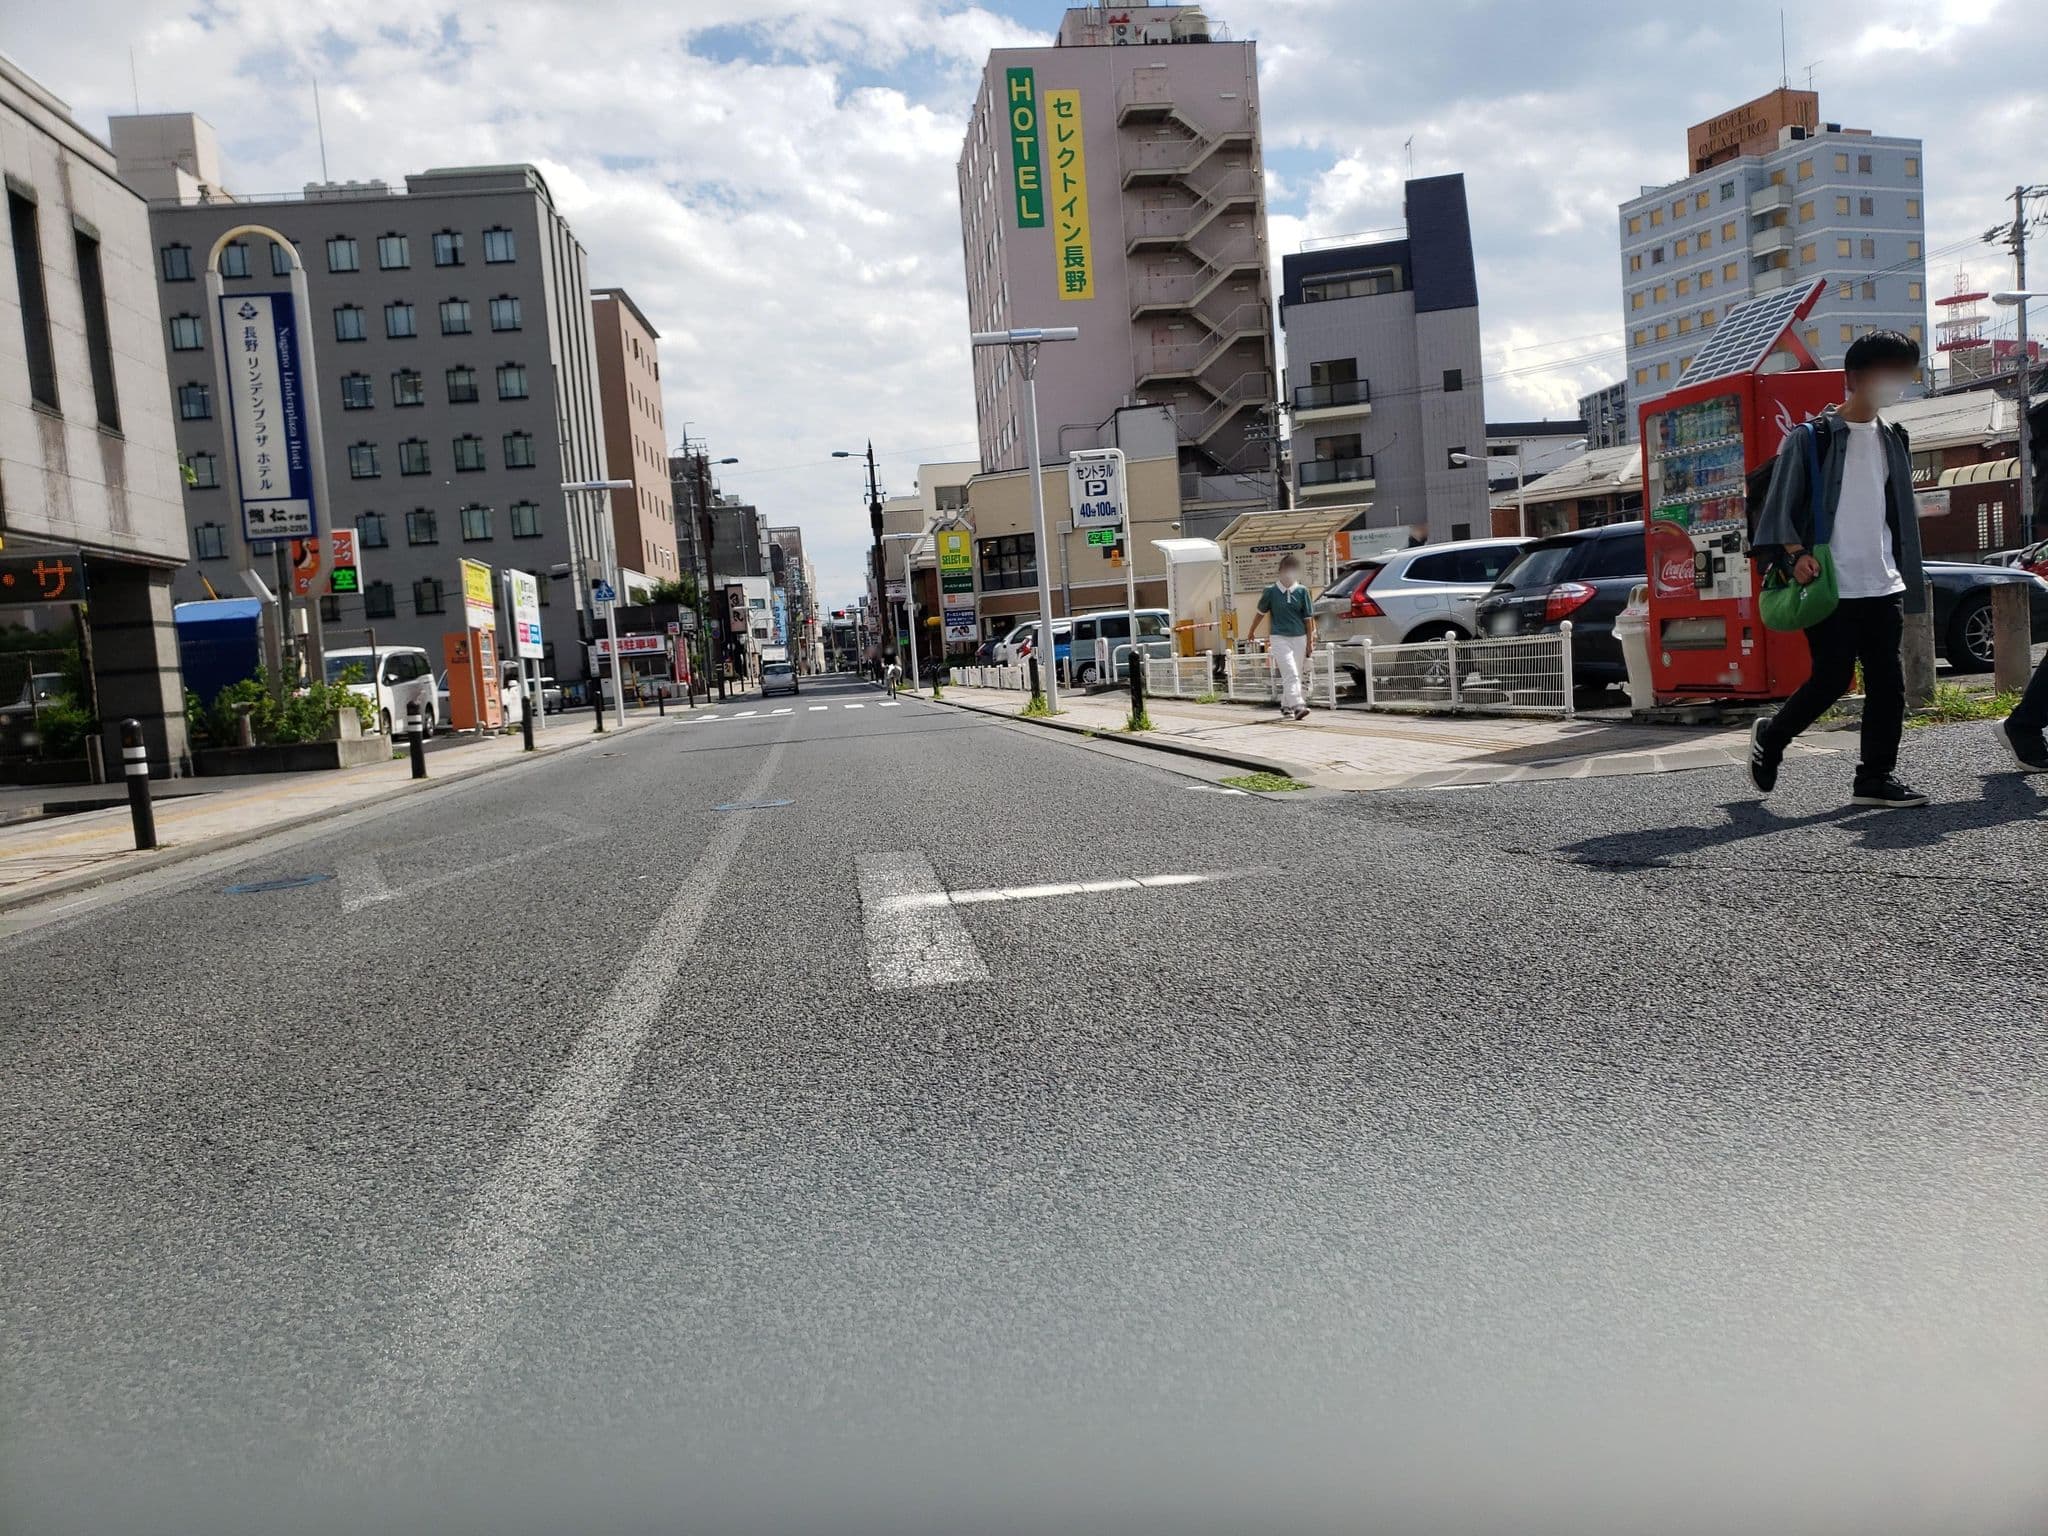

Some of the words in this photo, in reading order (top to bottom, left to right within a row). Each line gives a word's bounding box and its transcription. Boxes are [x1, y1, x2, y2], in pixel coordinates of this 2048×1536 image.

[1708, 107, 1752, 136] HOTEL
[1011, 77, 1040, 219] HOTEL
[1699, 118, 1768, 156] QUATTRO
[1053, 98, 1087, 293] セレクトイン長野
[279, 327, 291, 368] Nagano
[291, 441, 304, 470] Hotel
[1077, 464, 1114, 479] セントラル
[1087, 481, 1105, 496] P
[1080, 501, 1117, 518] 40分100円
[942, 554, 960, 564] SELECT
[333, 570, 358, 590] 空
